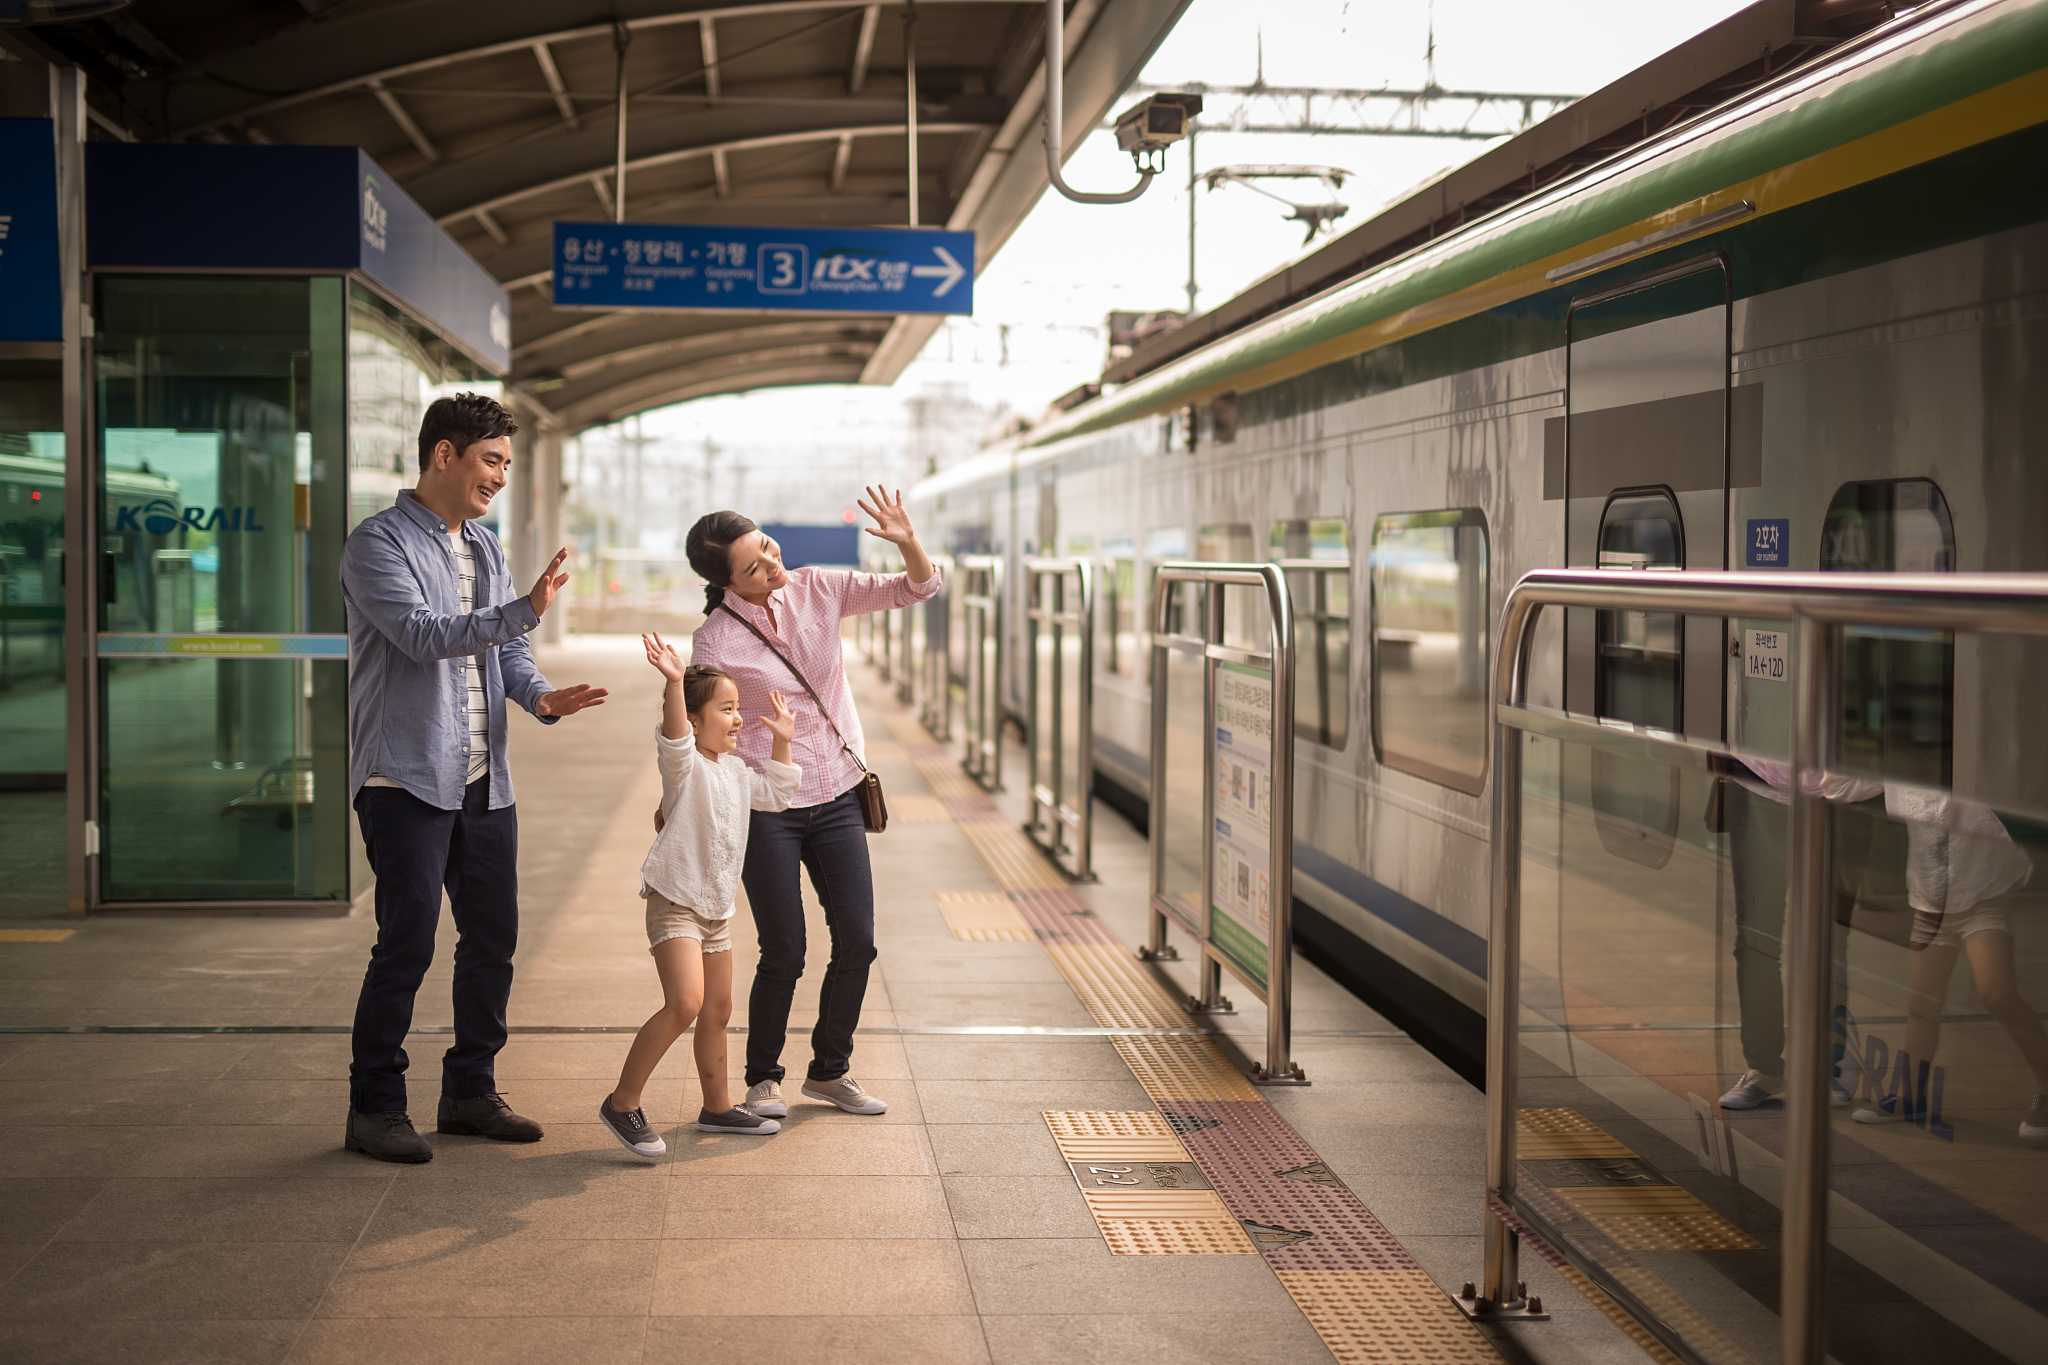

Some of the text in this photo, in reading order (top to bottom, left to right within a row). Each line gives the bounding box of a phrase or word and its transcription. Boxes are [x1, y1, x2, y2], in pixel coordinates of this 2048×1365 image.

[563, 237, 747, 266] 용산 청량리 가평
[771, 251, 795, 286] 3
[115, 500, 264, 535] KORAIL
[1755, 524, 1780, 550] 2호차
[1763, 552, 1779, 562] number
[182, 641, 264, 651] www.korail.com
[1755, 632, 1778, 649] 좌석번호
[1089, 1166, 1140, 1185] 2-2
